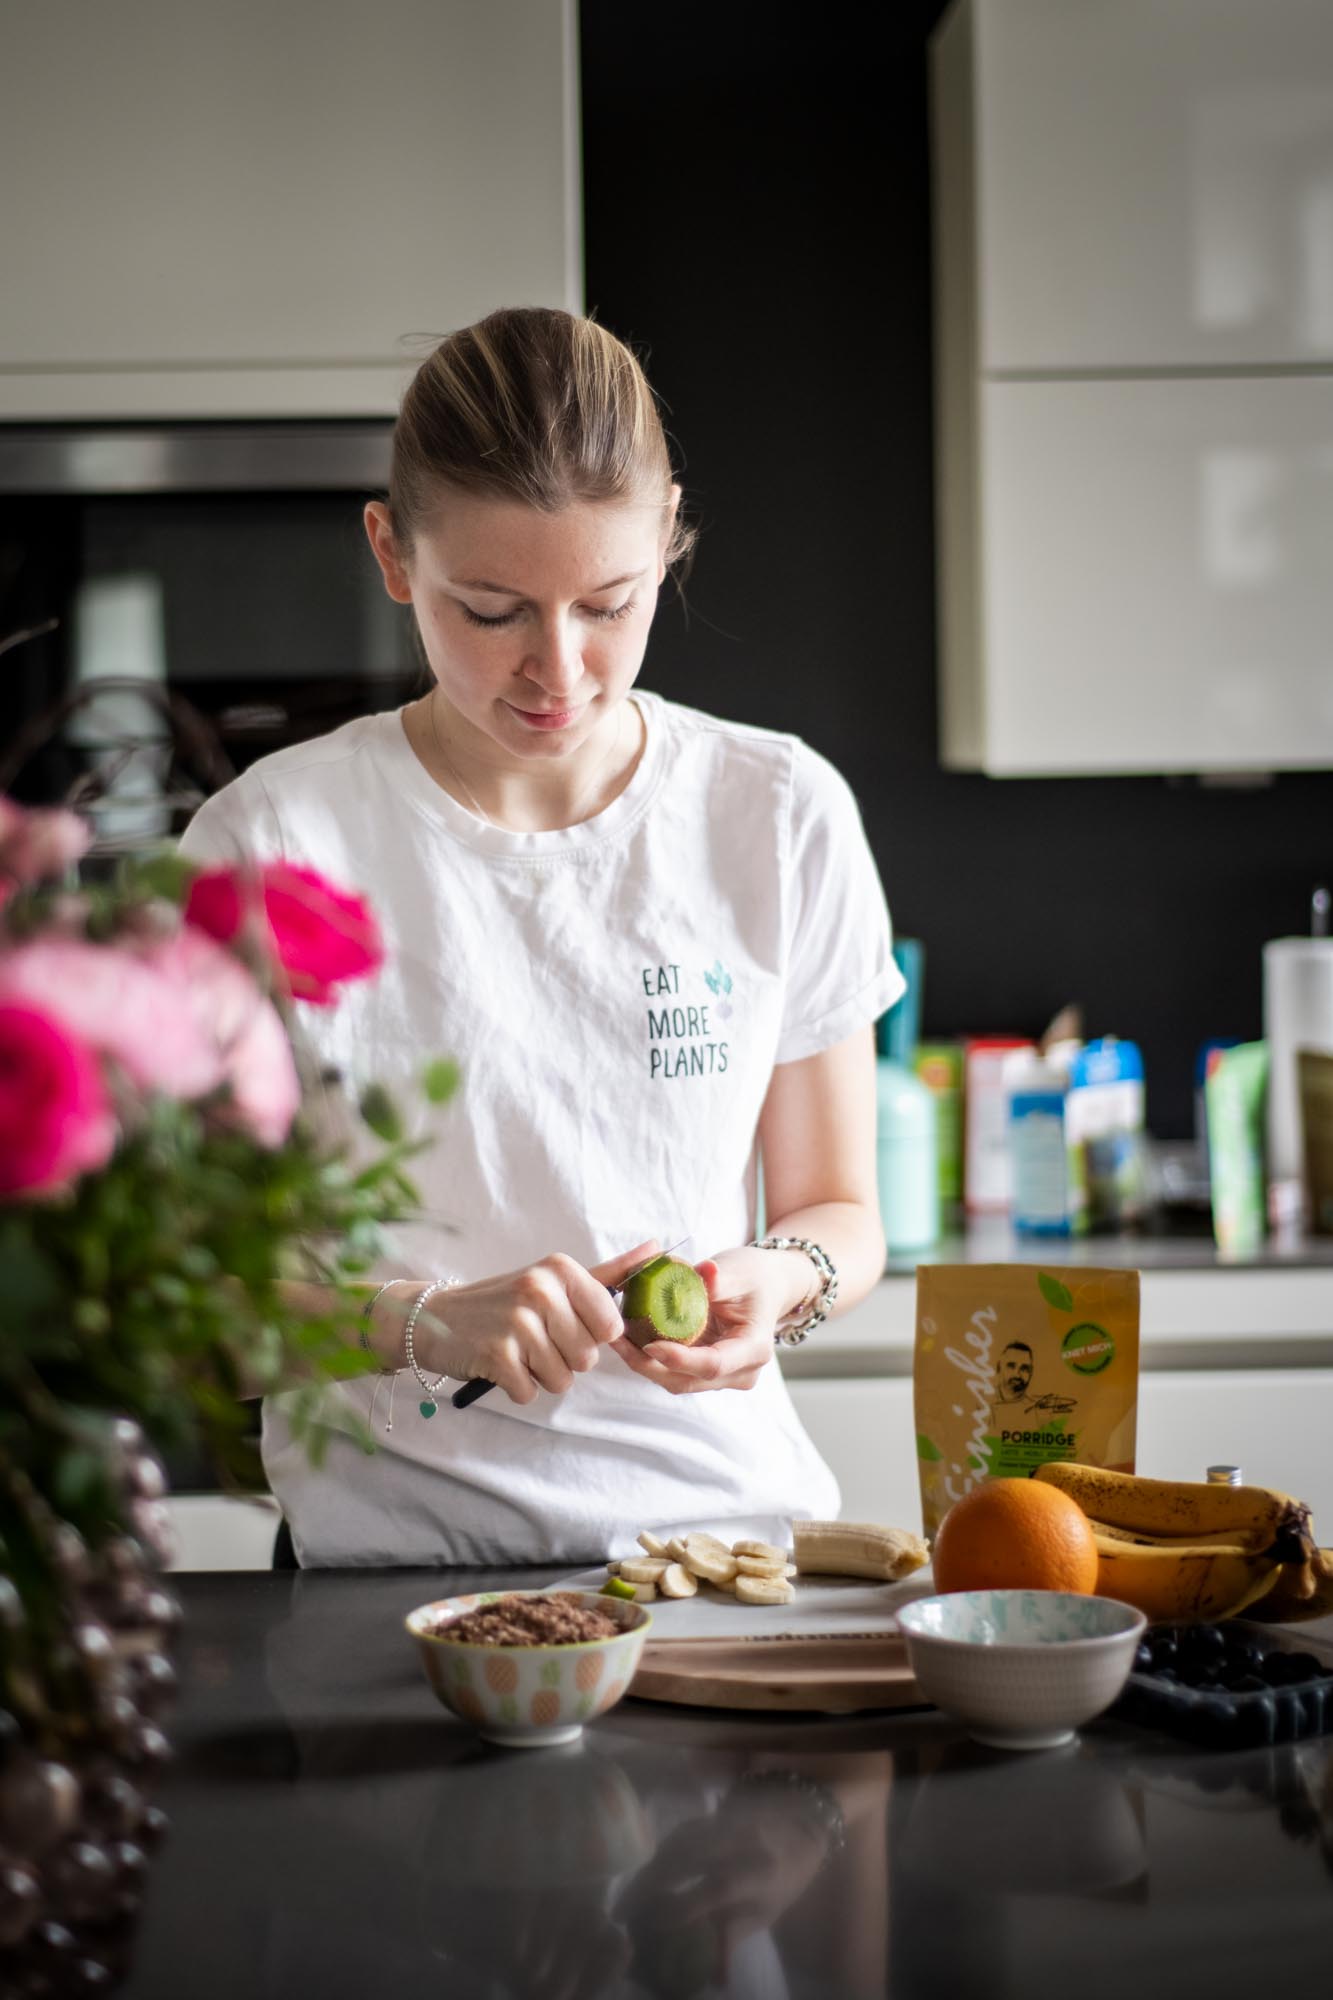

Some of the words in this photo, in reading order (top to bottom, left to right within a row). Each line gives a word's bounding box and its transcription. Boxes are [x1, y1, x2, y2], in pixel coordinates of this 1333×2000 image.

[642, 964, 681, 997] EAT
[647, 1006, 711, 1040] MORE
[650, 1042, 729, 1079] PLANTS
[1001, 1430, 1076, 1446] PORRIDGE
